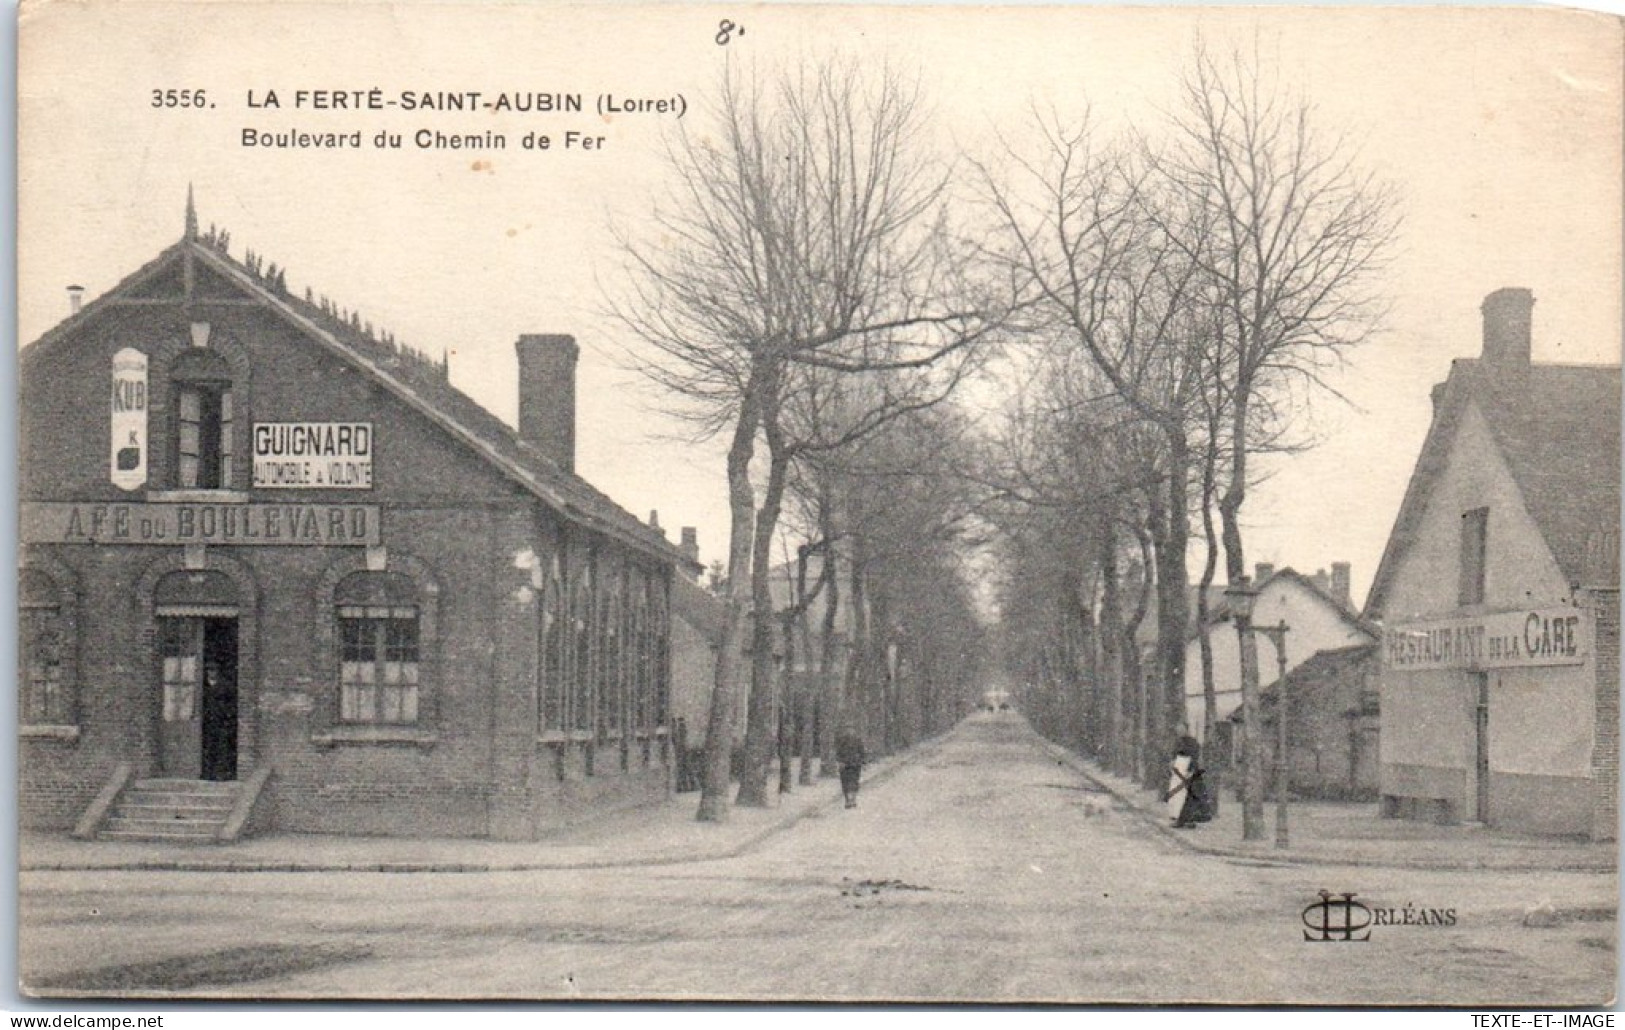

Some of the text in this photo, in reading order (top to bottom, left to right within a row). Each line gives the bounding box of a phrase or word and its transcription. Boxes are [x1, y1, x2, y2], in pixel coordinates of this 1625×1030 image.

[151, 87, 688, 119] 3556. LA FERTÉ-SAINT-AUBIN (Loiret)
[241, 128, 606, 150] Boulevard du Chemin de Fer
[113, 379, 145, 412] KUB
[256, 425, 368, 456] GUIGNARD
[254, 461, 311, 484] AUTOMOBILE
[62, 506, 131, 540] AFE
[177, 505, 367, 538] BOULEVARD
[1387, 624, 1485, 664] RESTAURANT
